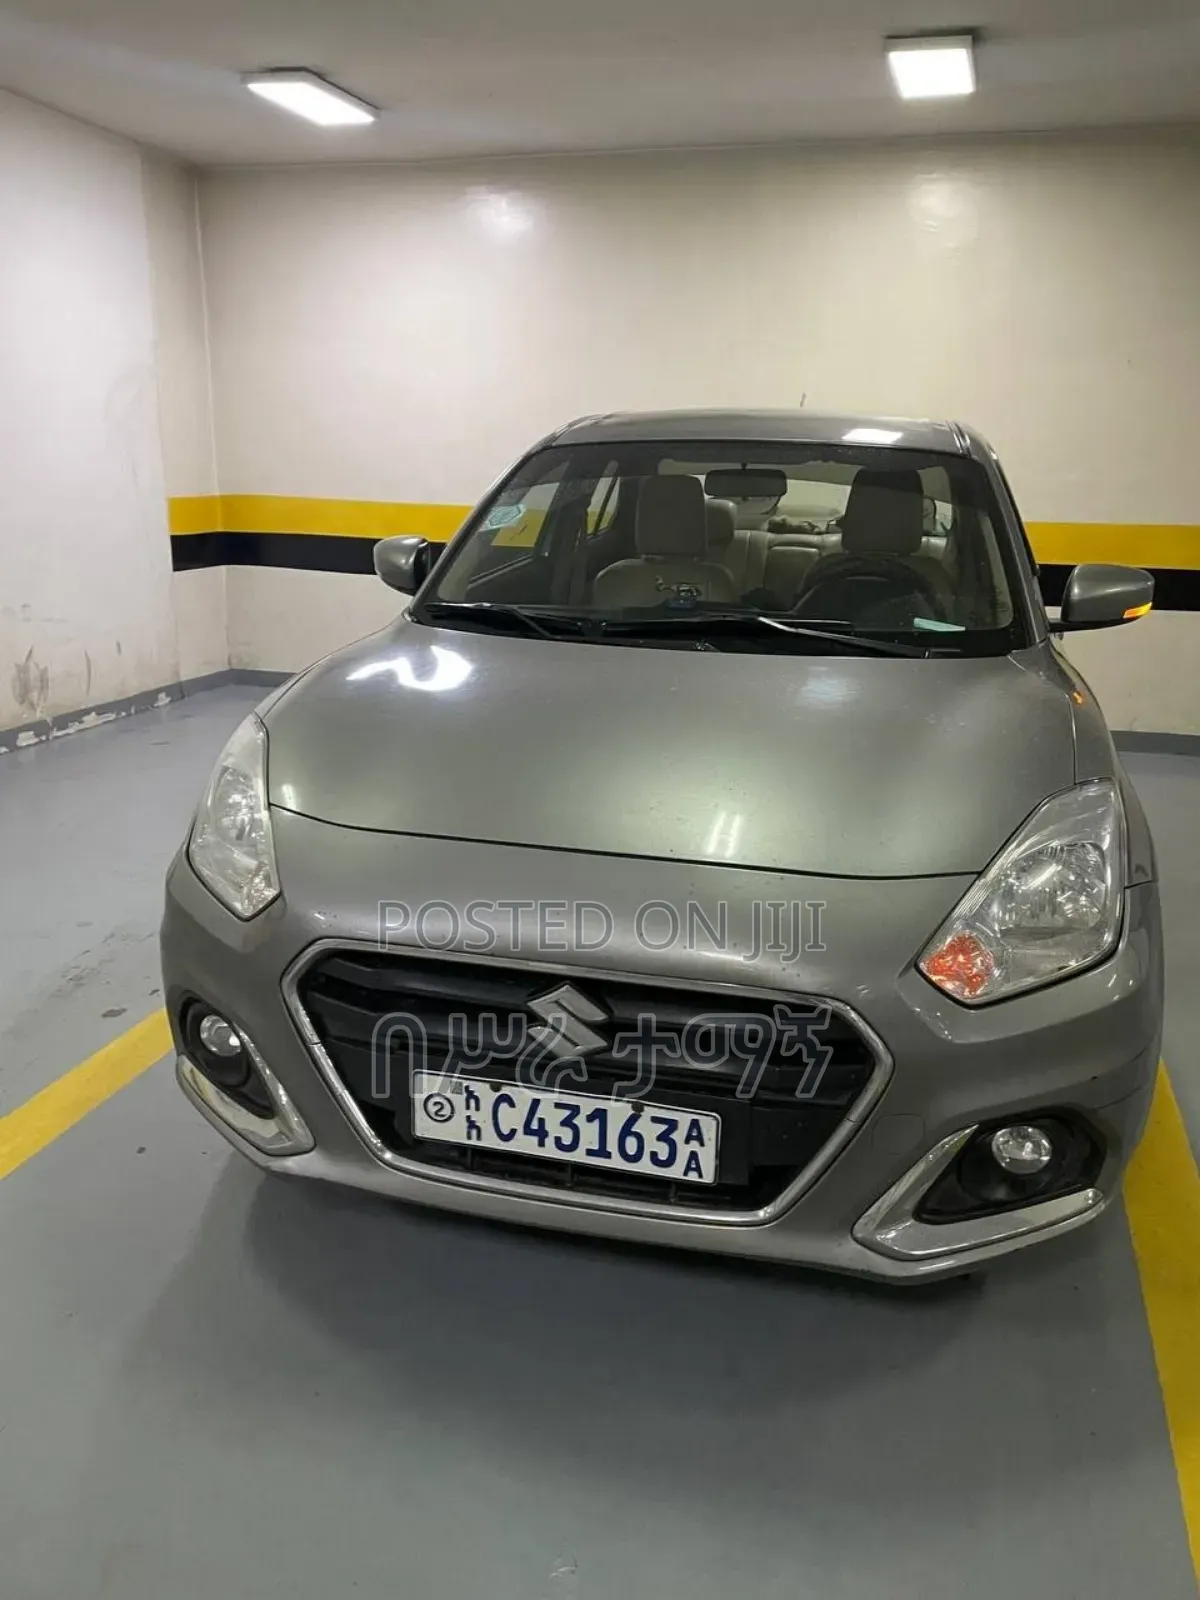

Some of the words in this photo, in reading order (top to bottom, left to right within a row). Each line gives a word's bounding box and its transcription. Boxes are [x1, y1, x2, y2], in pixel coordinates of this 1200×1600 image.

[491, 1093, 679, 1168] C43163
[684, 1118, 705, 1147] A
[683, 1150, 704, 1179] A
